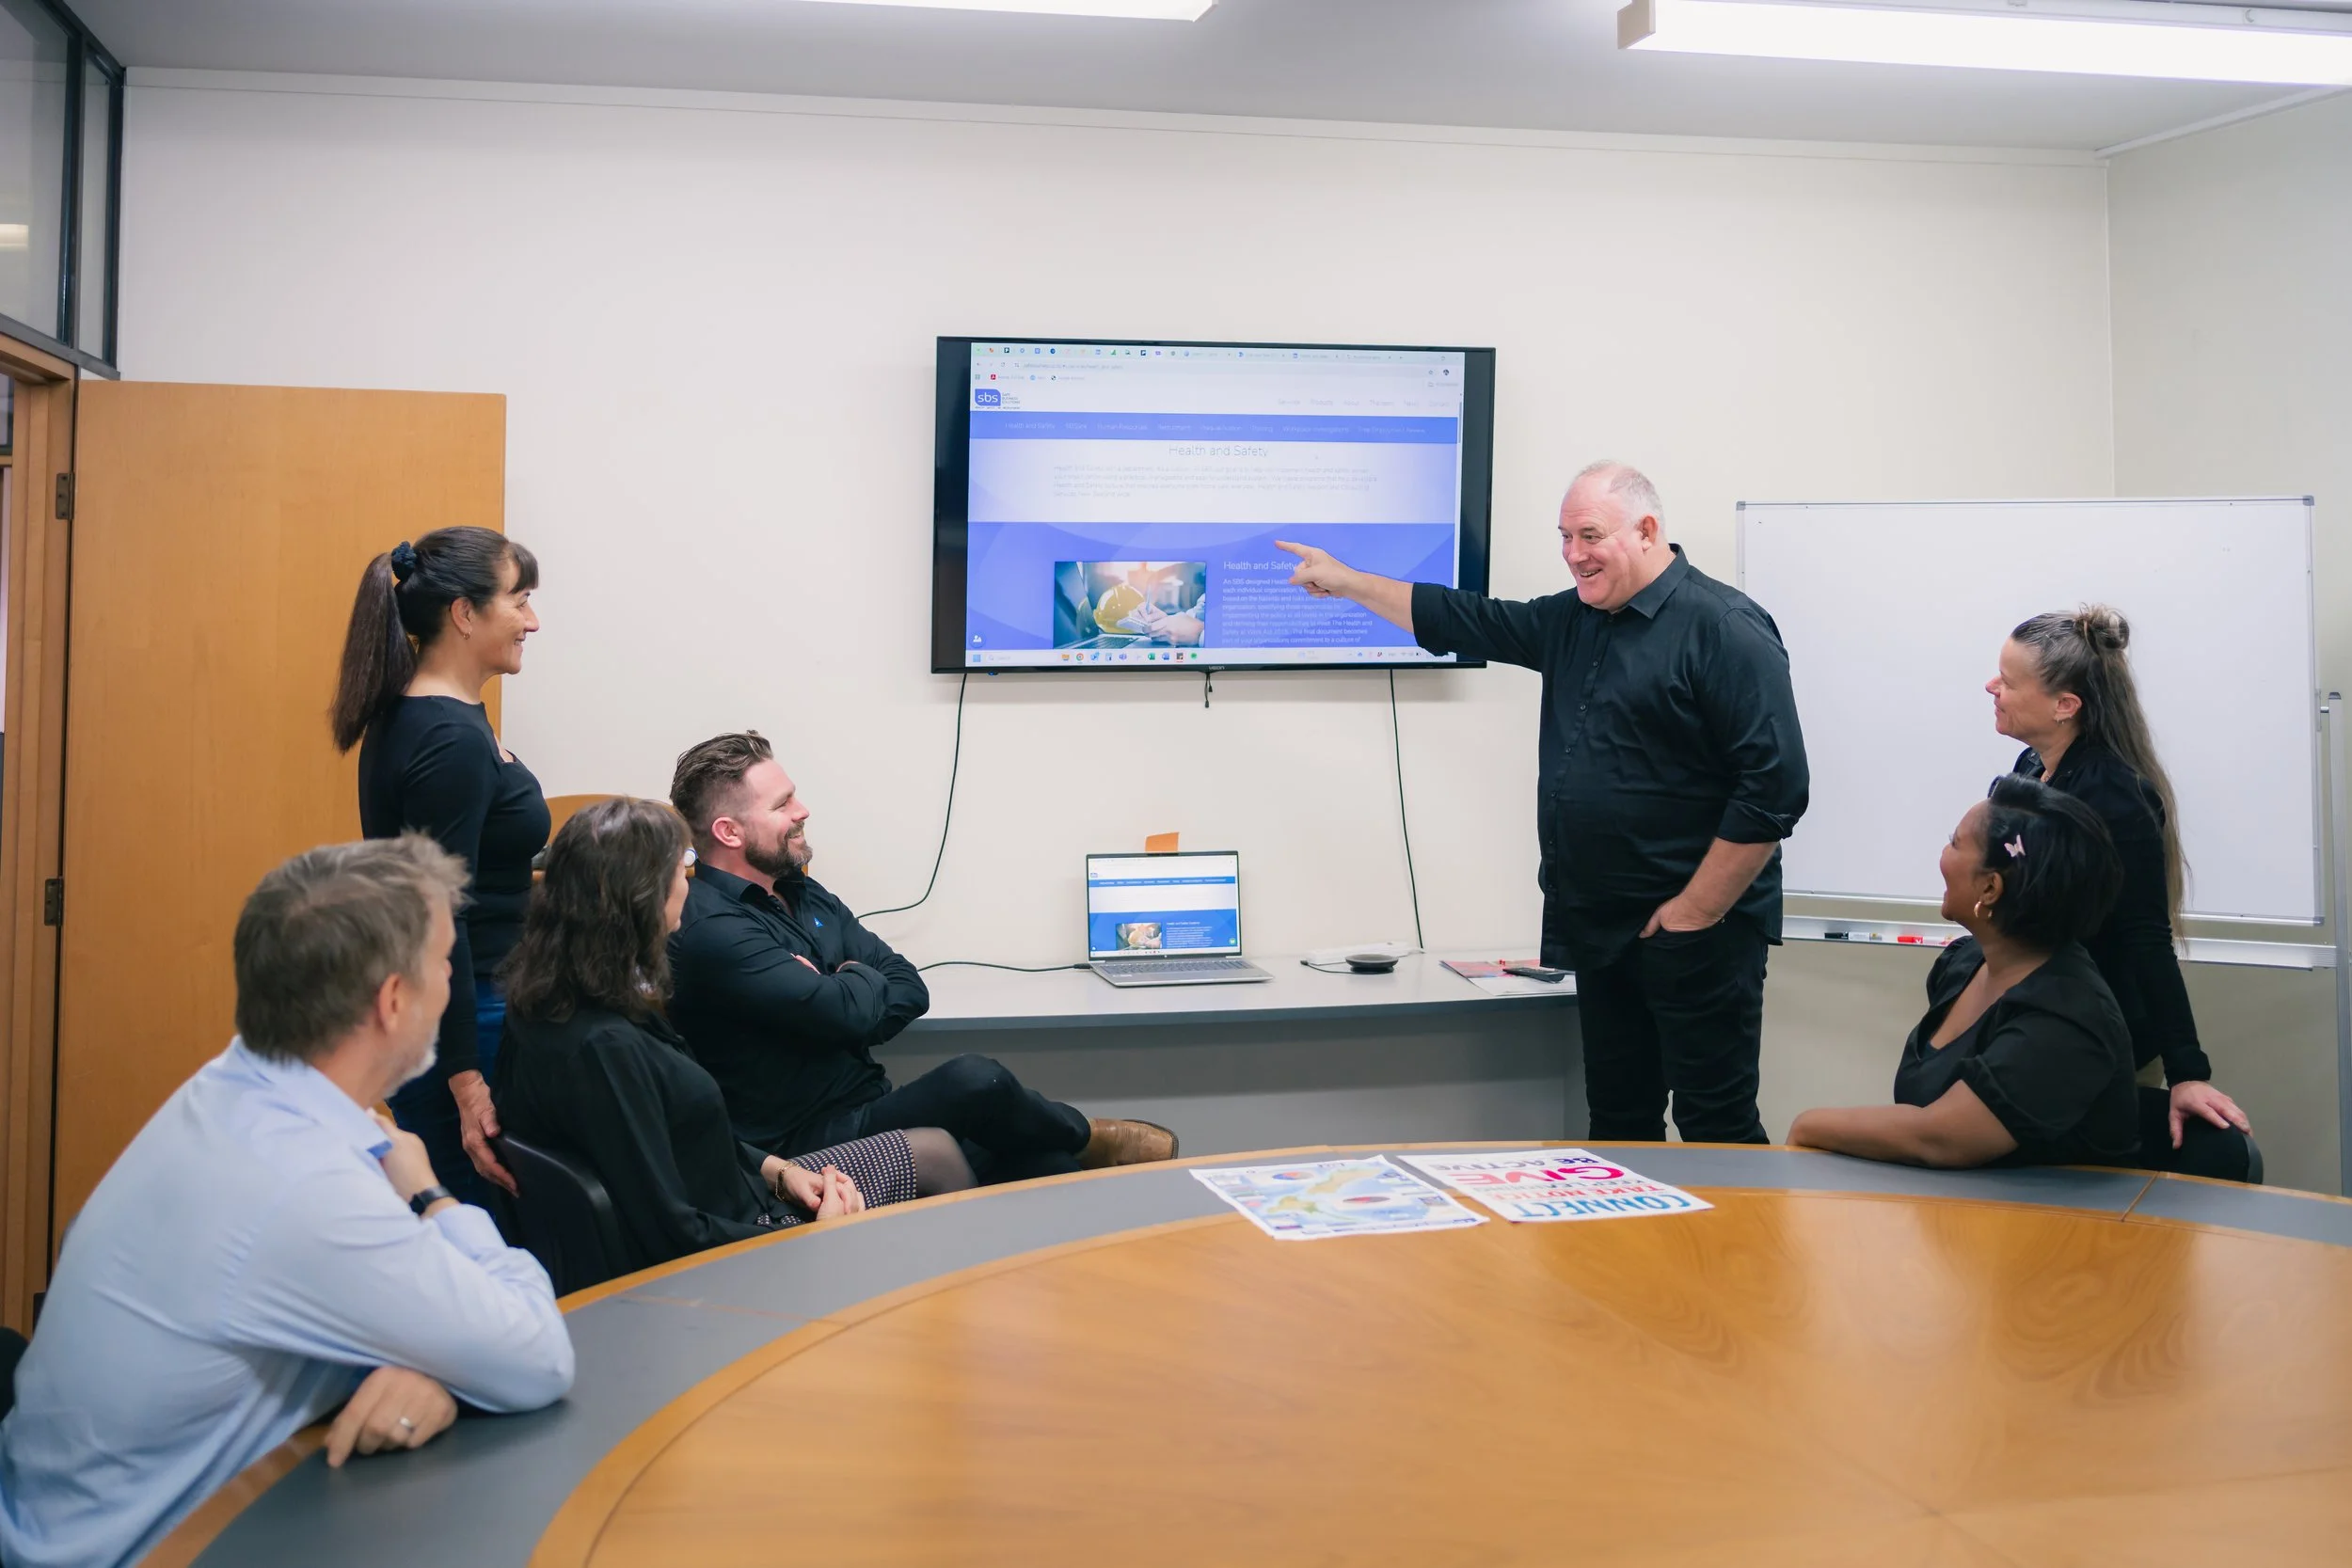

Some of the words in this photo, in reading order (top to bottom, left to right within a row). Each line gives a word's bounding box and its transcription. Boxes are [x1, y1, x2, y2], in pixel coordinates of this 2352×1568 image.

[977, 392, 998, 403] sbs
[1168, 444, 1206, 456] Health
[1210, 446, 1231, 456] and
[1233, 445, 1268, 459] Safety
[1223, 561, 1251, 570] Health
[1253, 562, 1269, 570] and
[1271, 562, 1295, 571] Safety
[1429, 1159, 1546, 1171] ACTIVE
[1447, 1165, 1625, 1185] GIVE
[1488, 1189, 1587, 1200] NOTICE
[1590, 1183, 1665, 1195] TAKE
[1511, 1194, 1691, 1218] CONNECT
